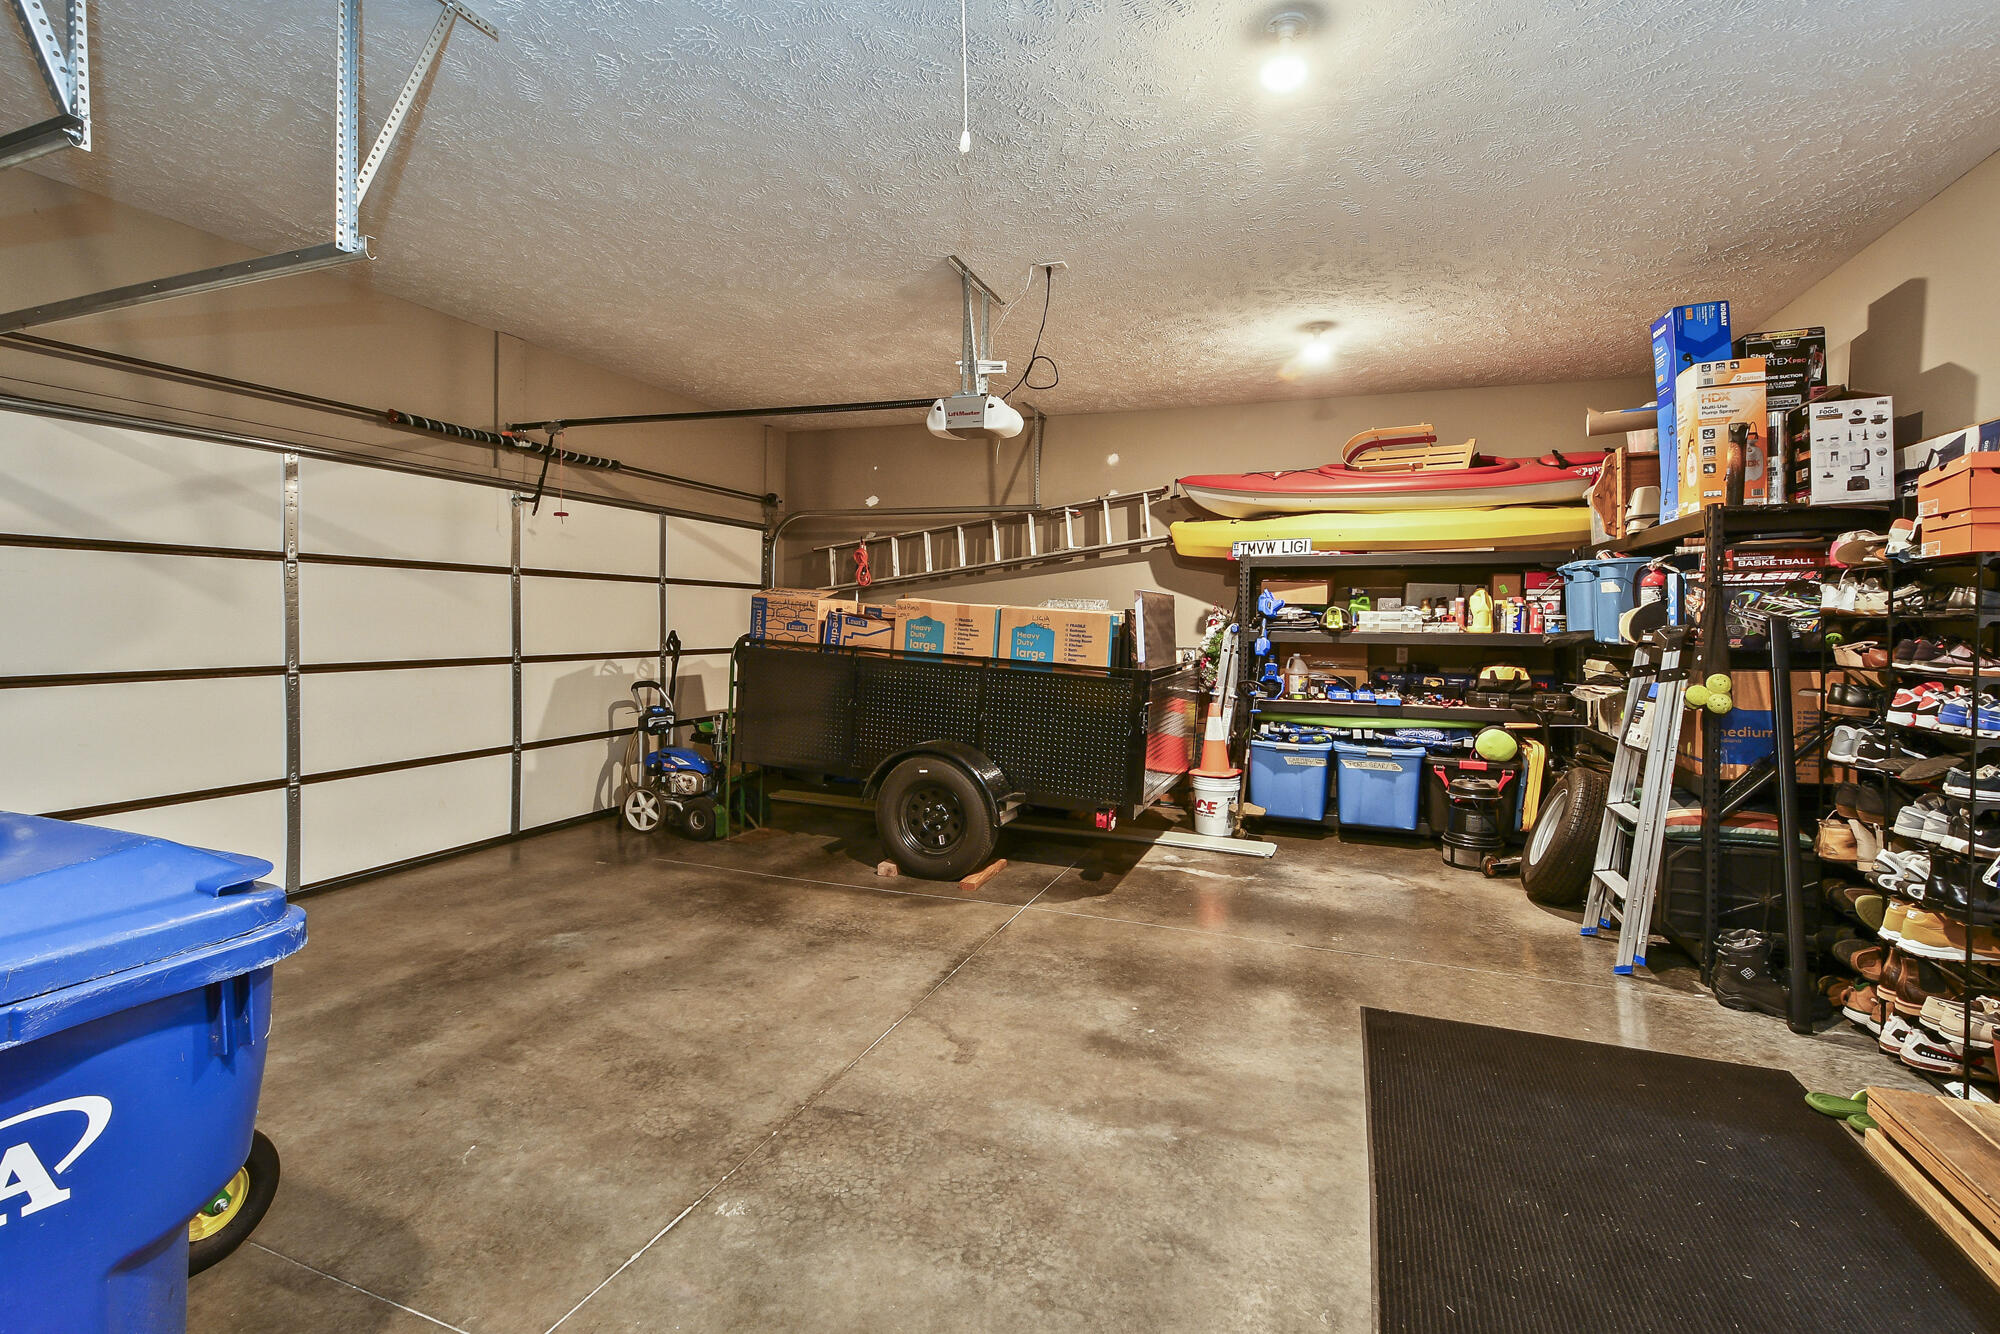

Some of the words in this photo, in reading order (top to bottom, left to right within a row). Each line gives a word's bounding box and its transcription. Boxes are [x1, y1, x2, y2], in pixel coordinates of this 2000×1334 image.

[1720, 302, 1728, 326] KOBALT
[1766, 357, 1791, 366] RTEX
[1701, 391, 1732, 404] HDX
[1241, 541, 1276, 555] TMVW
[1281, 540, 1307, 553] LIGI
[1738, 558, 1815, 567] BASKETBALL
[830, 612, 840, 645] mediu
[910, 623, 932, 632] Heavy
[910, 631, 926, 639] Duty
[1016, 631, 1040, 640] Heavy
[909, 639, 937, 652] large
[1016, 639, 1034, 647] Duty
[1016, 648, 1046, 662] large
[1194, 799, 1218, 815] CE
